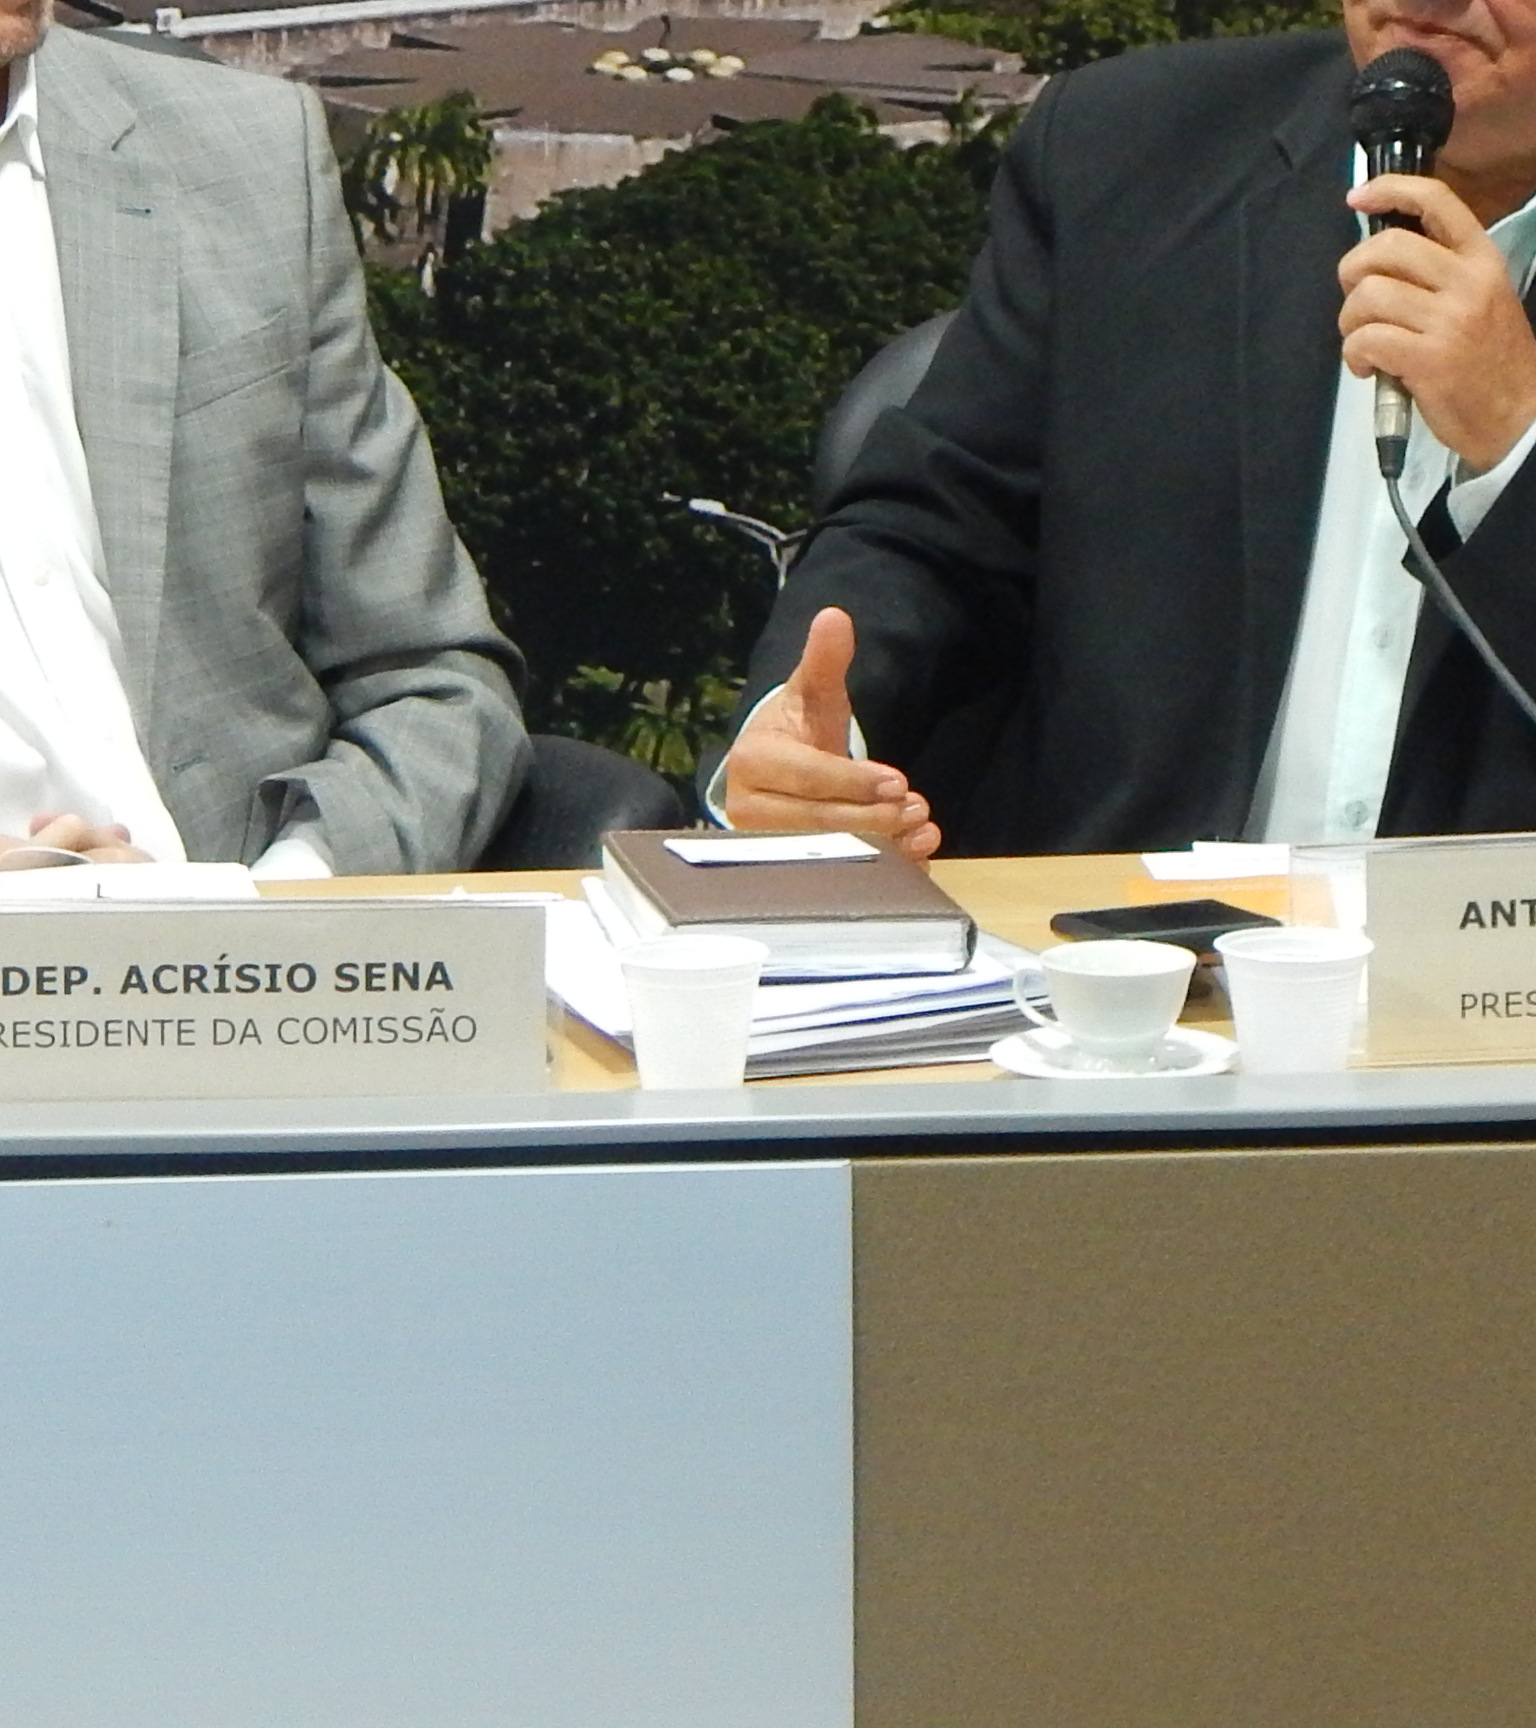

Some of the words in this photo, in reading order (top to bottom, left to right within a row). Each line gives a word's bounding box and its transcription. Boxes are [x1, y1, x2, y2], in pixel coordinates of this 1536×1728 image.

[1, 965, 102, 997] DEP.
[119, 952, 317, 995] ACRÍSIO
[334, 960, 454, 993] SENA
[212, 1017, 263, 1046] DA
[276, 1007, 478, 1046] COMISSÃO
